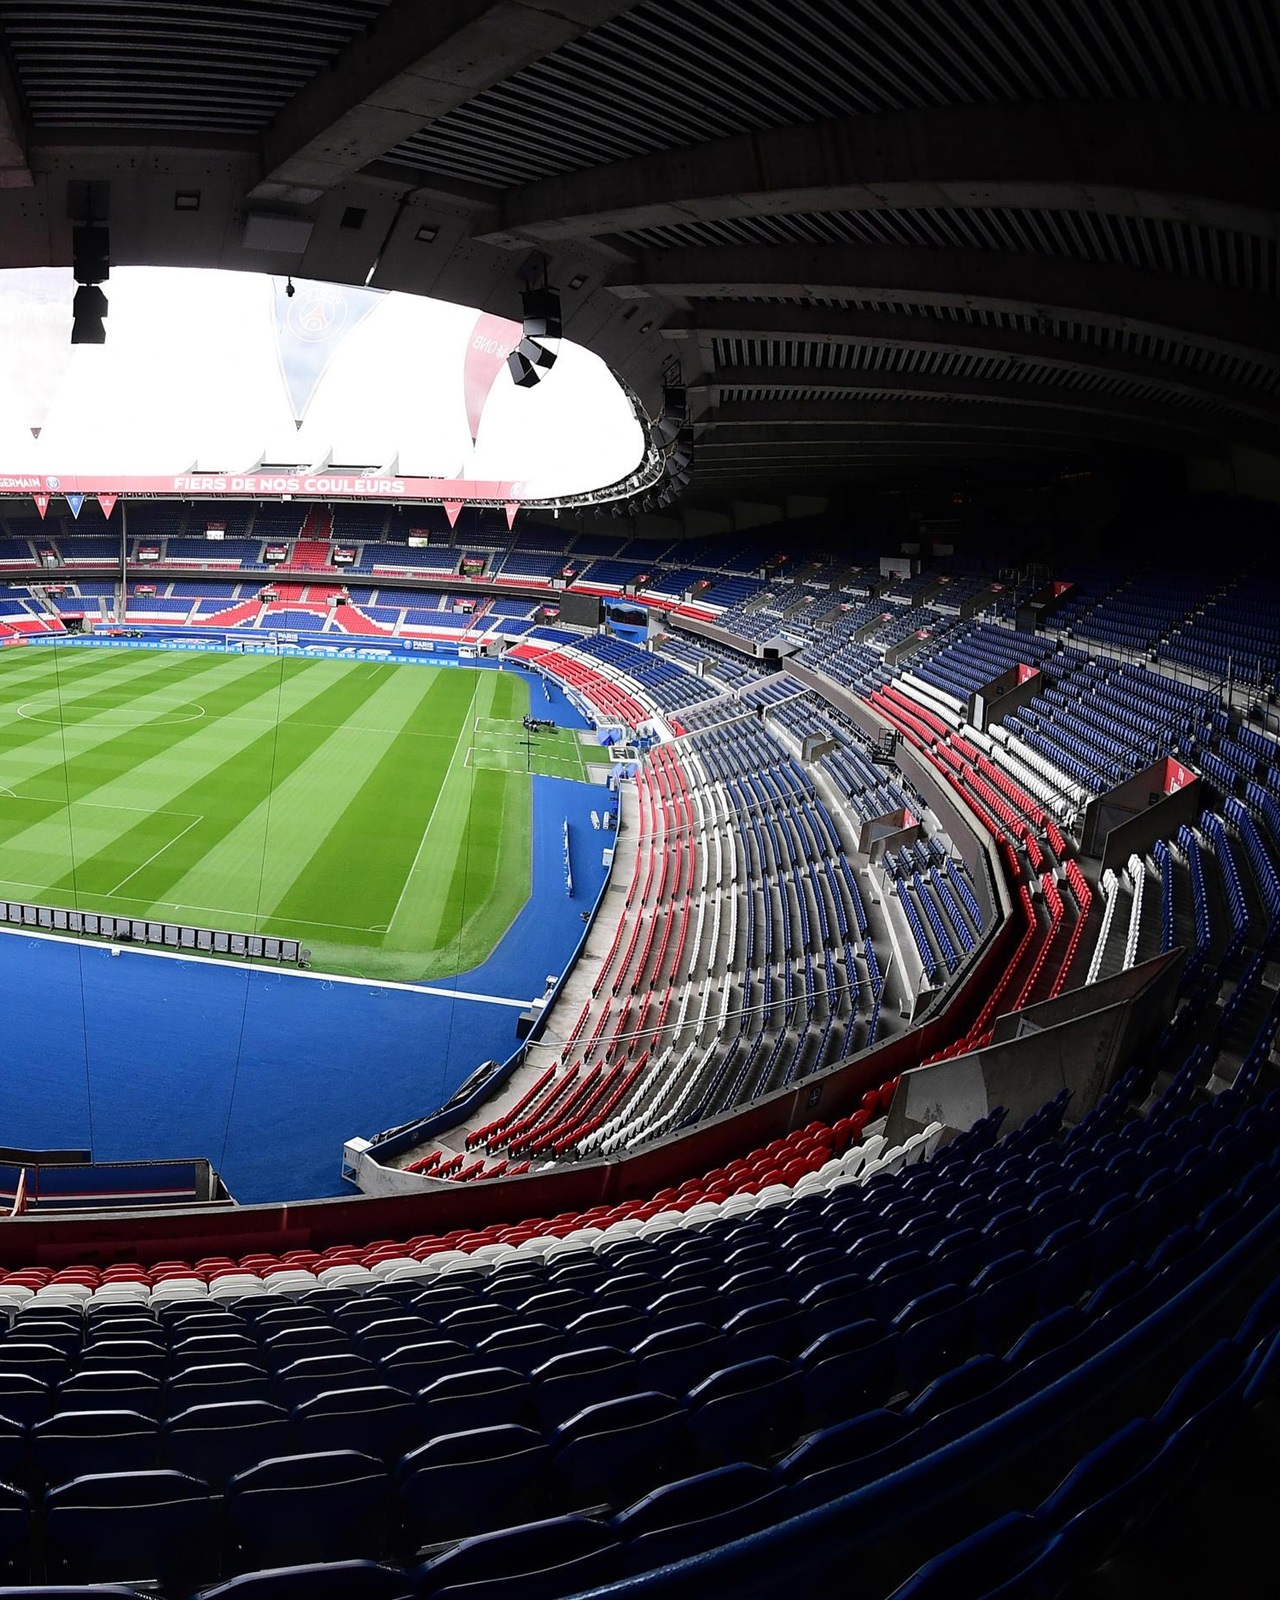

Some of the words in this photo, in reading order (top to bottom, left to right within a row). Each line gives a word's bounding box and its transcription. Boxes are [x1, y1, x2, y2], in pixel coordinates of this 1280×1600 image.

[173, 476, 227, 491] FIERS
[231, 478, 257, 492] DE
[260, 478, 300, 492] NOS
[304, 478, 406, 494] COULEURS
